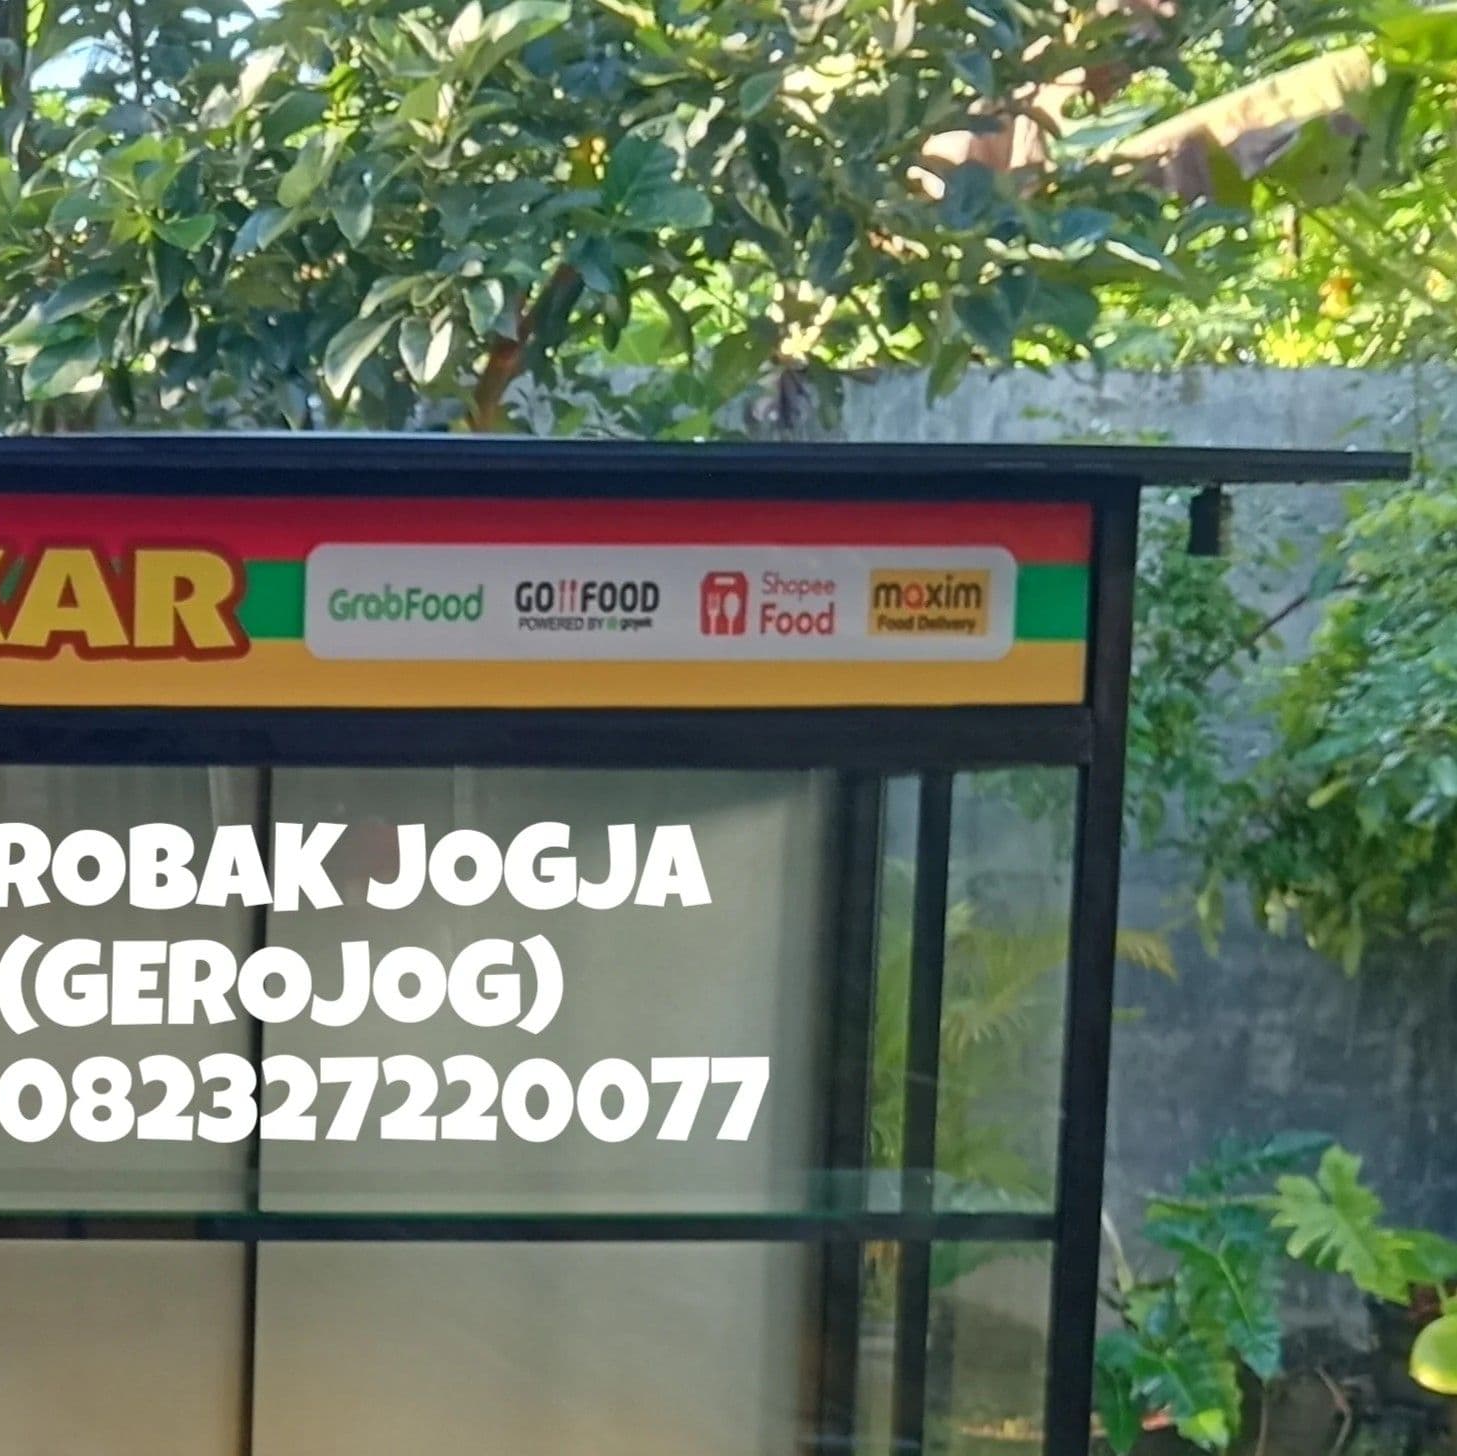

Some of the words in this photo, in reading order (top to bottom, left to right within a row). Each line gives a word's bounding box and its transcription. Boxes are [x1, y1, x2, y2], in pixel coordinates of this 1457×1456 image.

[761, 571, 836, 600] Shopee
[873, 575, 984, 609] maxim
[328, 583, 485, 622] GrabFood
[518, 617, 584, 632] POWERED
[587, 617, 605, 631] BY
[760, 602, 835, 636] Food
[877, 616, 914, 630] Food
[918, 615, 976, 634] Delivery
